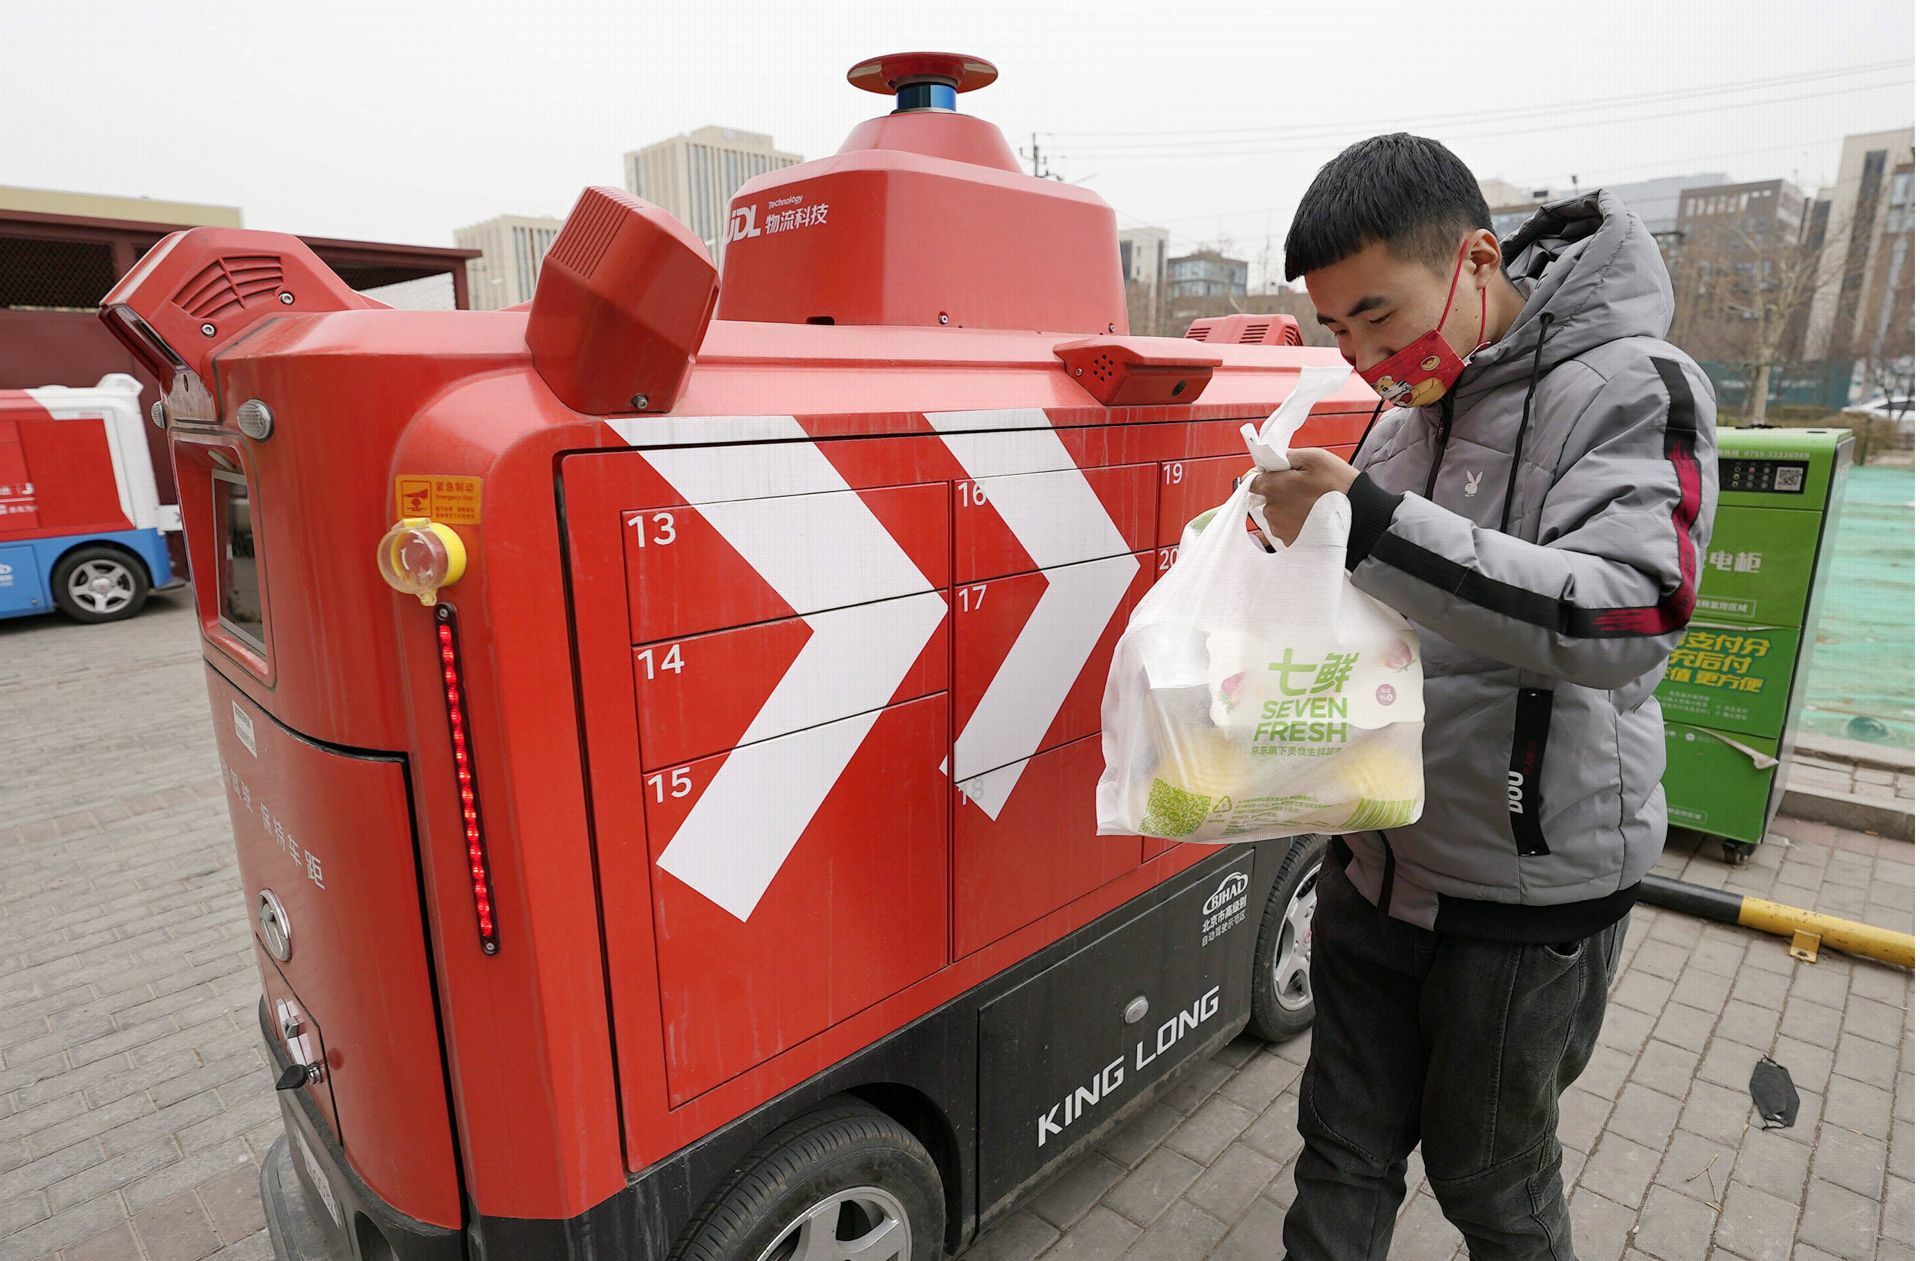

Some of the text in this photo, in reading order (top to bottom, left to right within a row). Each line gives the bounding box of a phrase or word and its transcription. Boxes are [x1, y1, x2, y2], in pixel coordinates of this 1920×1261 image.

[768, 195, 803, 209] Technology
[765, 203, 829, 235] 物流科技
[1163, 463, 1183, 485] 19
[957, 480, 987, 508] 16
[627, 512, 676, 548] 13
[1703, 550, 1763, 574] 电柜
[958, 584, 988, 613] 17
[637, 644, 685, 680] 14
[1268, 647, 1360, 697] 七鲜
[1261, 697, 1348, 720] SEVEN
[1253, 720, 1348, 743] FRESH
[647, 767, 693, 803] 15
[1038, 985, 1220, 1148] KING LONG
